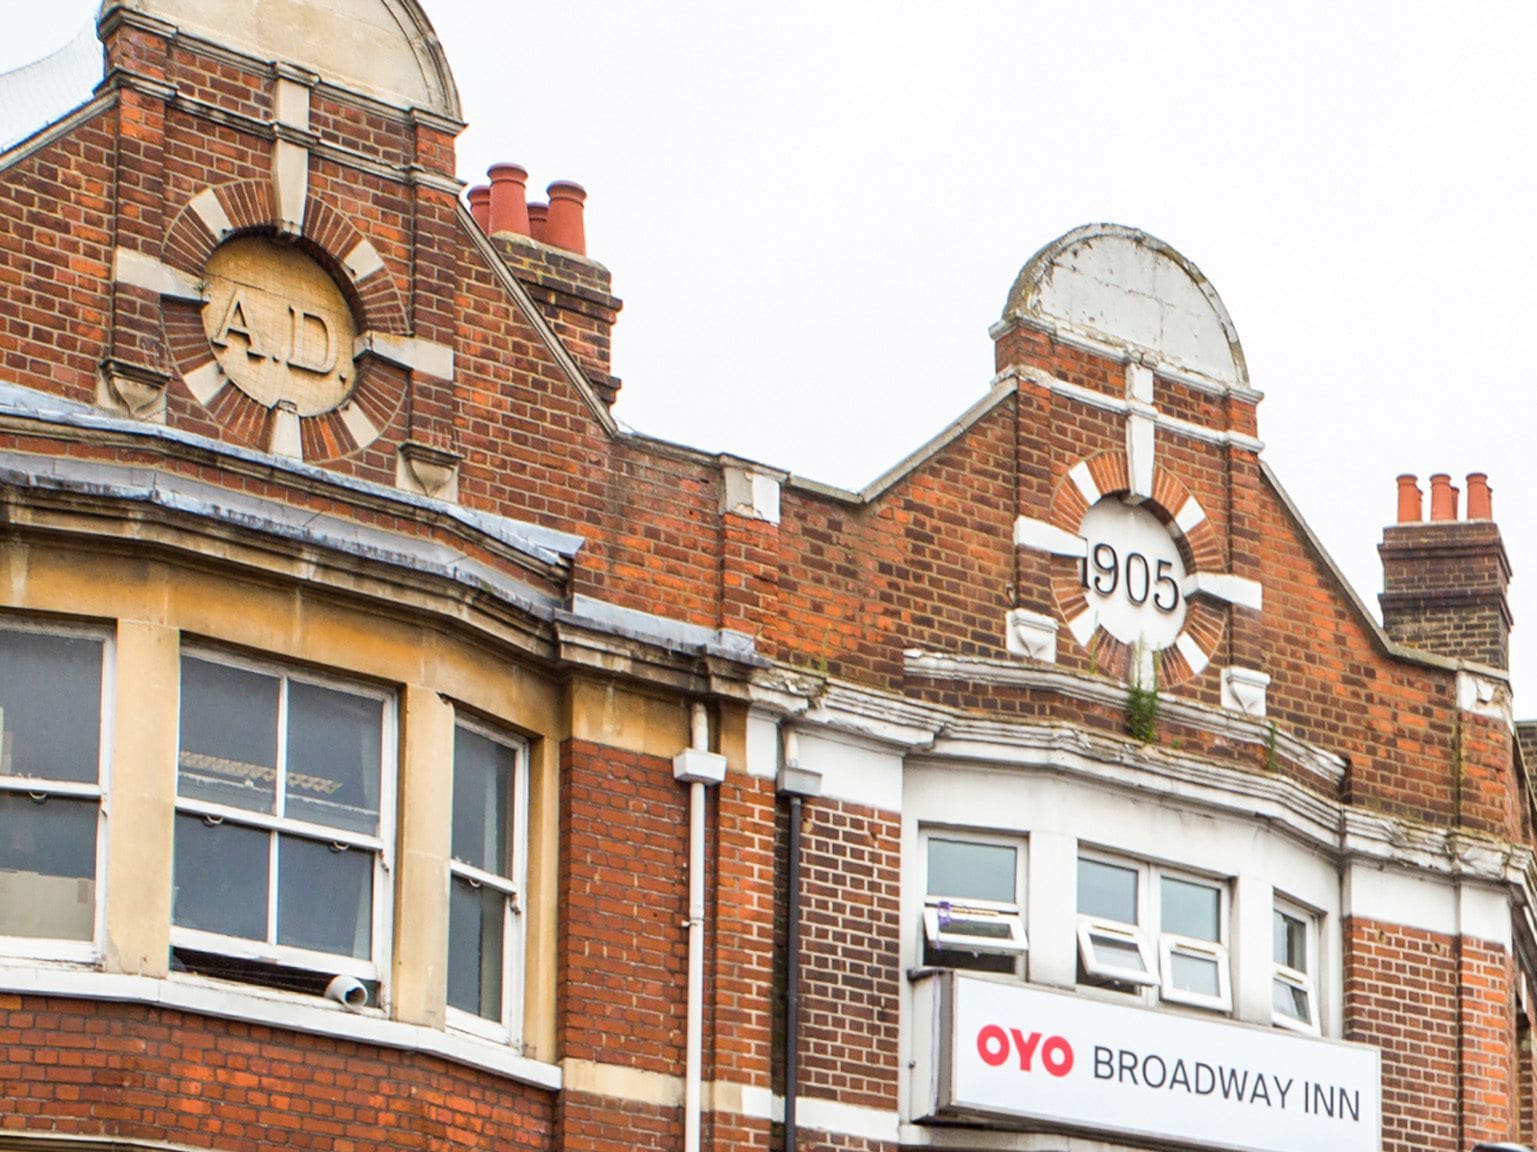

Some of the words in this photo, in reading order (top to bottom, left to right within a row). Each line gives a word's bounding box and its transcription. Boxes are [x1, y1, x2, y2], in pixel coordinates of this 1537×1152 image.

[976, 1023, 1074, 1078] OYO
[1092, 1044, 1296, 1110] BROADWAY
[1304, 1081, 1361, 1122] INN
